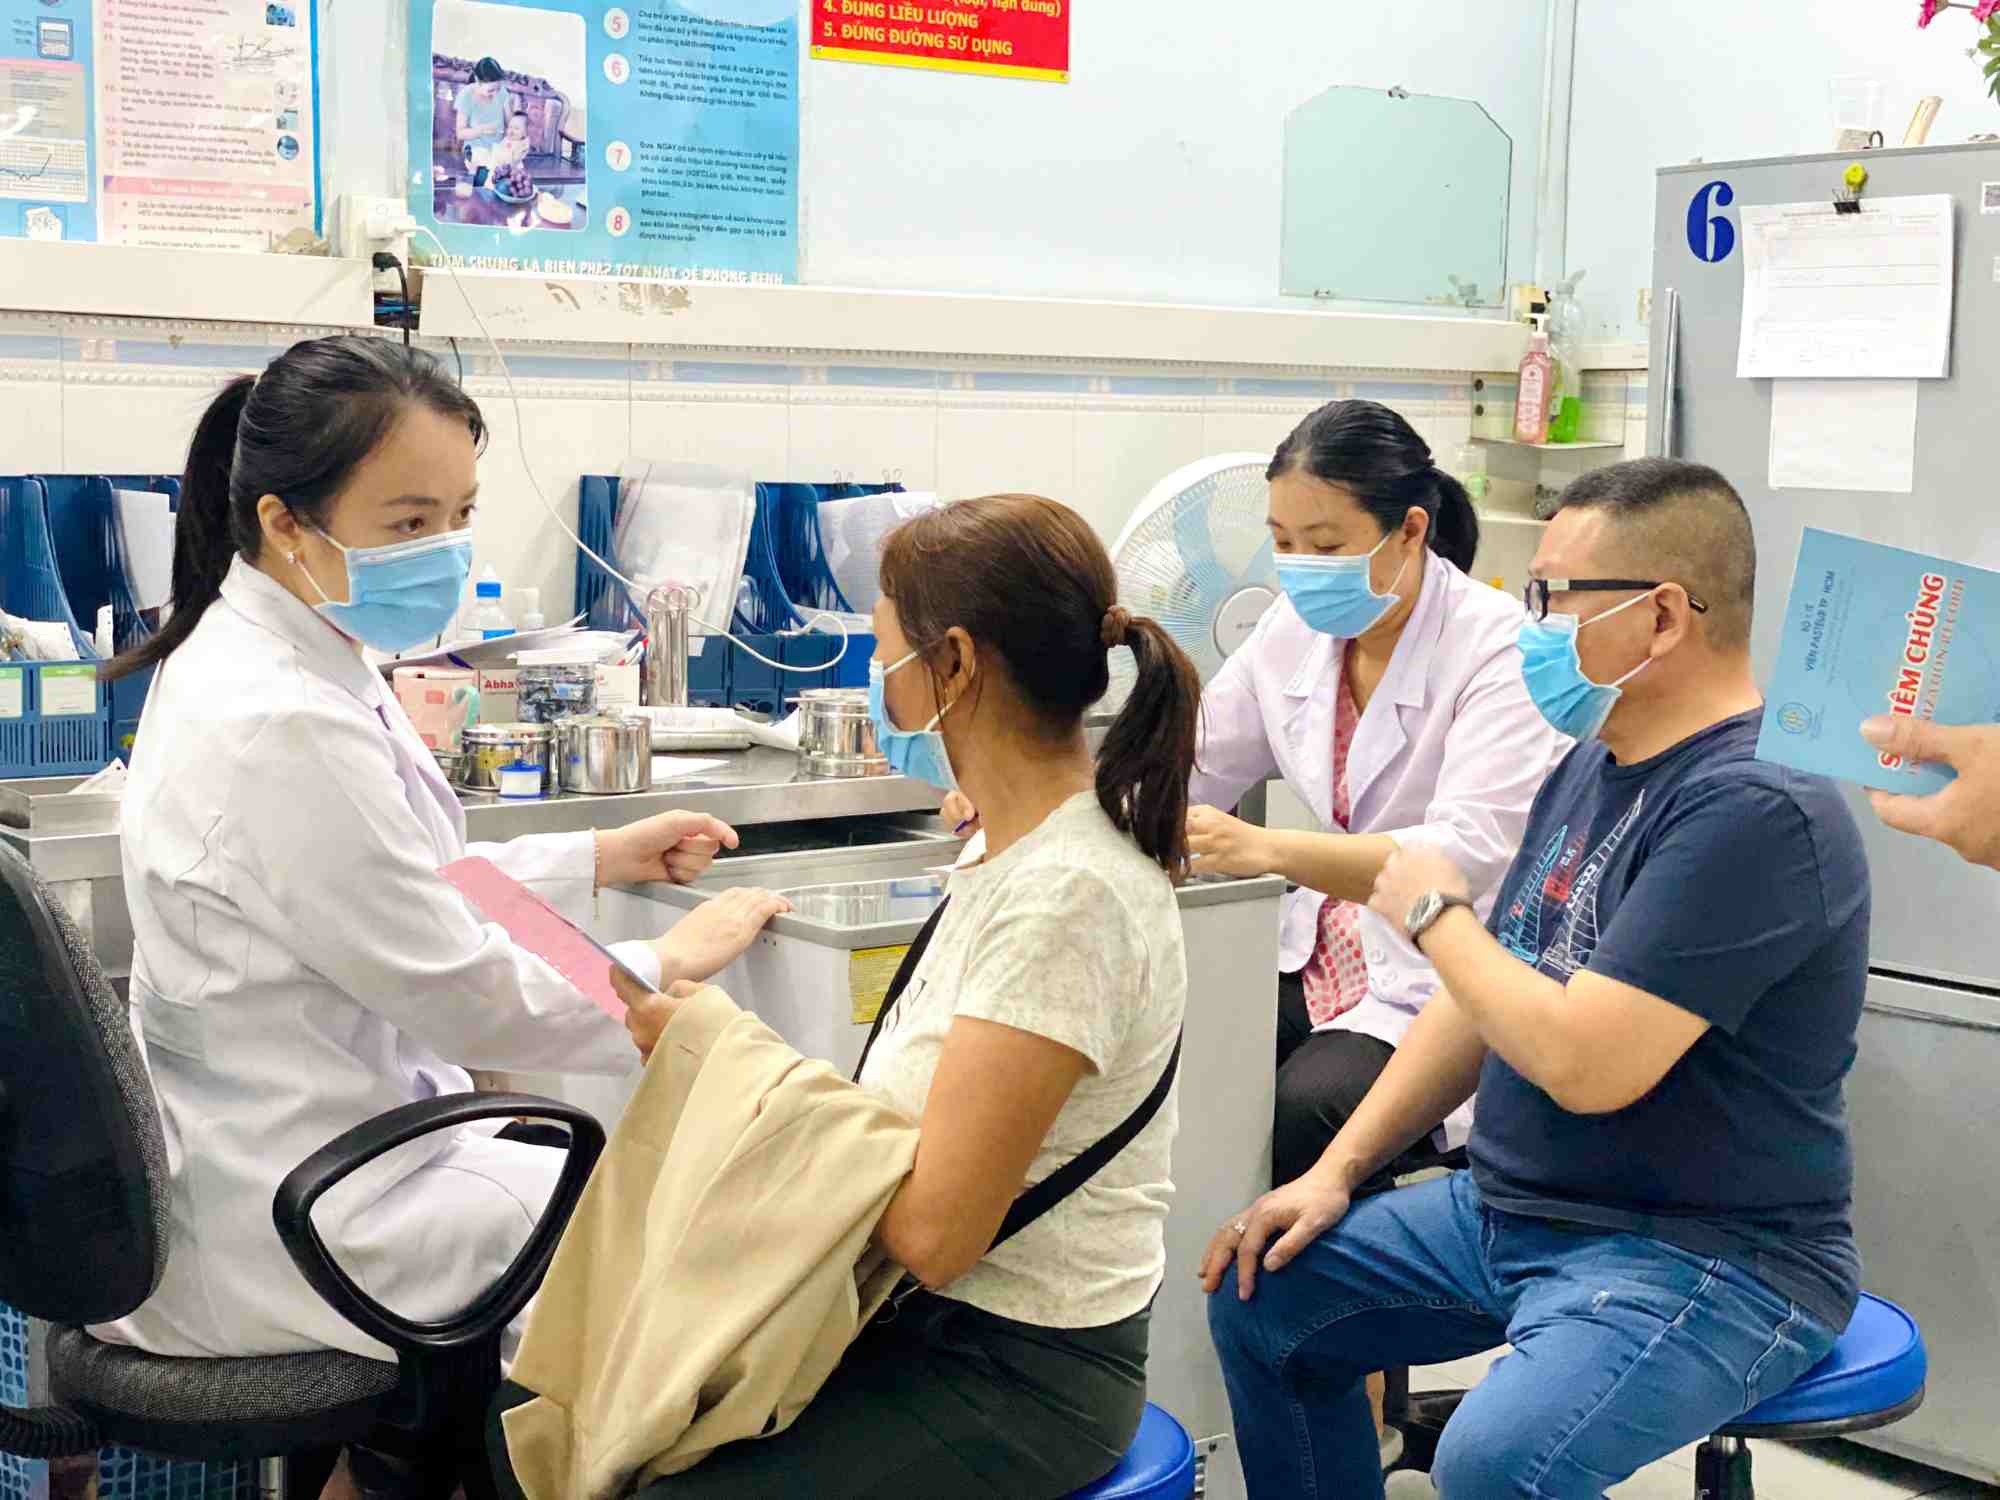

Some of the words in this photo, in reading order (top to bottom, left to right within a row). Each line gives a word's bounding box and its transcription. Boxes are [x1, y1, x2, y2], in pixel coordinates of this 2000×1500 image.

[612, 16, 622, 32] 5
[823, 0, 838, 13] 4.
[928, 9, 978, 29] LƯỢNG
[824, 21, 838, 37] 5.
[842, 20, 885, 42] ĐÚNG
[889, 27, 944, 48] ĐƯỜNG
[972, 37, 1012, 56] DỤNG
[612, 61, 622, 77] 6
[613, 215, 623, 231] 8
[1686, 181, 1735, 263] 6
[1905, 574, 1945, 665] CHỦNG
[1888, 668, 1922, 715] IÊM
[1879, 750, 1901, 769] S
